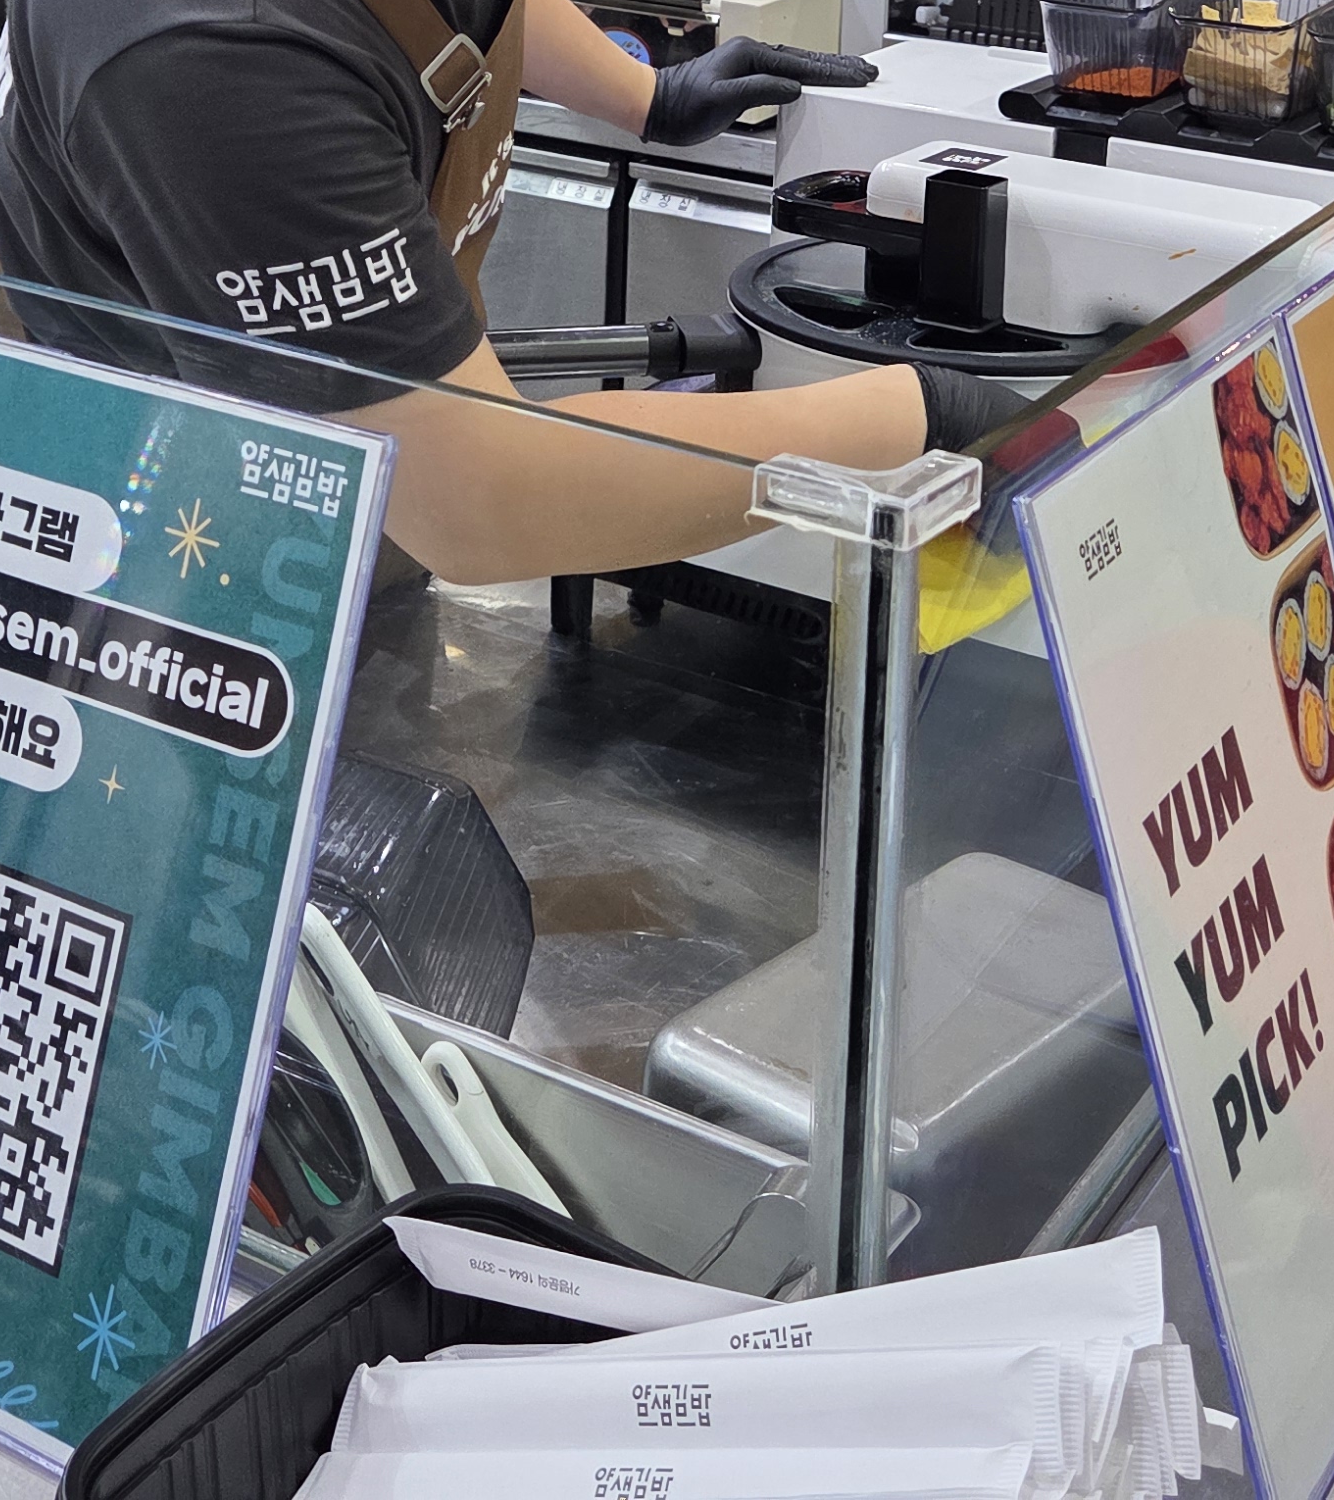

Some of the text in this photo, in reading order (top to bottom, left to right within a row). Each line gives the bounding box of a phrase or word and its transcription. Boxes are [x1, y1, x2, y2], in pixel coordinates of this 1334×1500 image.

[216, 228, 418, 336] 얌샘김밥
[240, 440, 348, 518] 얌샘김밥
[1078, 518, 1123, 581] 얌샘김밥
[1142, 725, 1253, 898] YUM
[1174, 853, 1284, 1036] YUM
[1212, 968, 1324, 1183] PICK!
[92, 983, 235, 1425] GIMBA
[469, 1257, 496, 1275] 3378
[509, 1267, 534, 1285] 1644
[538, 1273, 581, 1297] 가맹문의
[632, 1384, 712, 1427] 얌샘김밥
